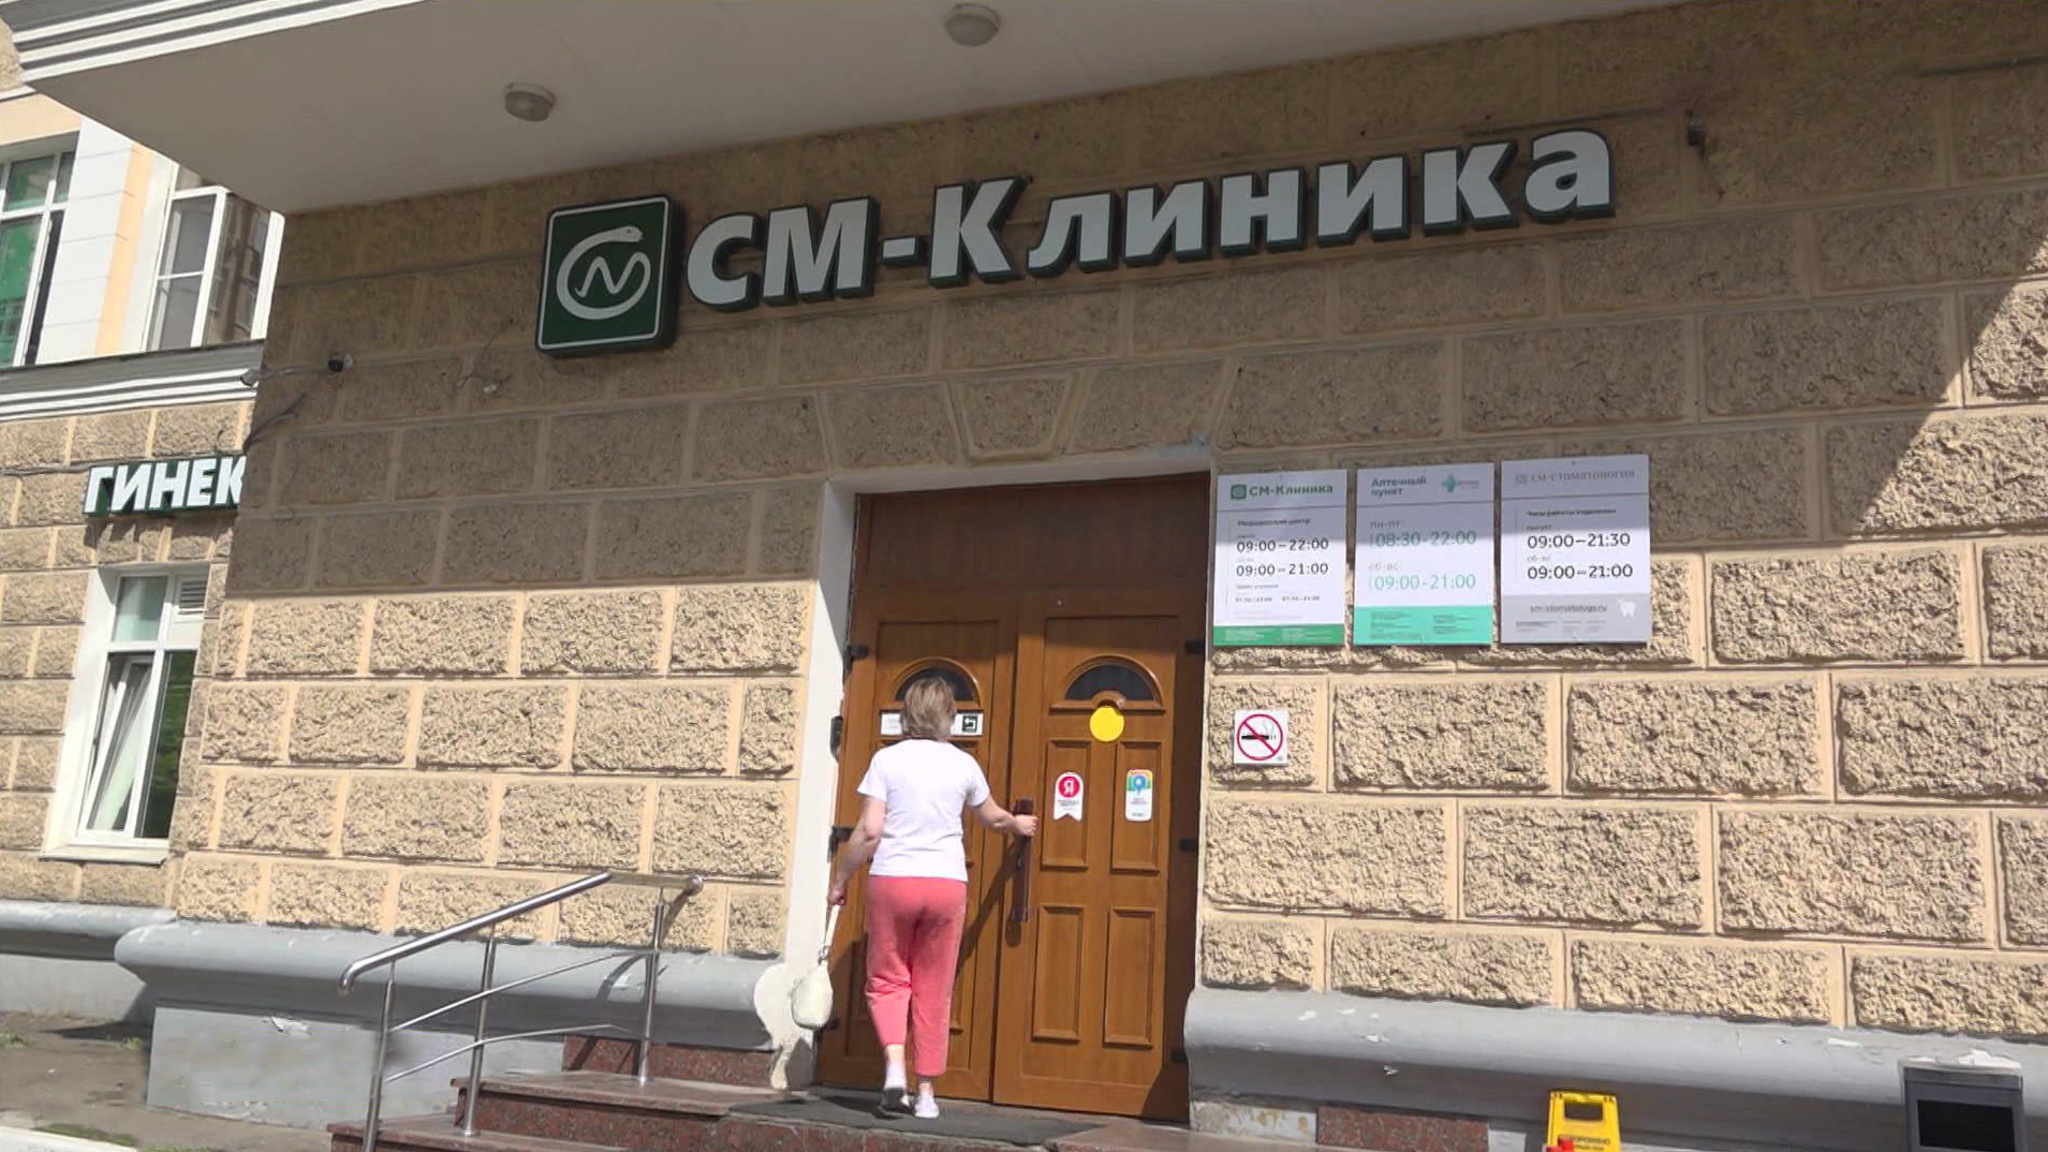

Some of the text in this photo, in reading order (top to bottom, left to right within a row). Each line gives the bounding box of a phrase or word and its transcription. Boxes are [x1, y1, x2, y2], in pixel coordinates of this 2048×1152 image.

[686, 128, 1616, 310] СМ-Клиника
[1371, 475, 1427, 487] Аптечный
[1249, 483, 1333, 497] СМ-Клиника
[1371, 488, 1403, 497] пункт
[1063, 780, 1074, 795] Я
